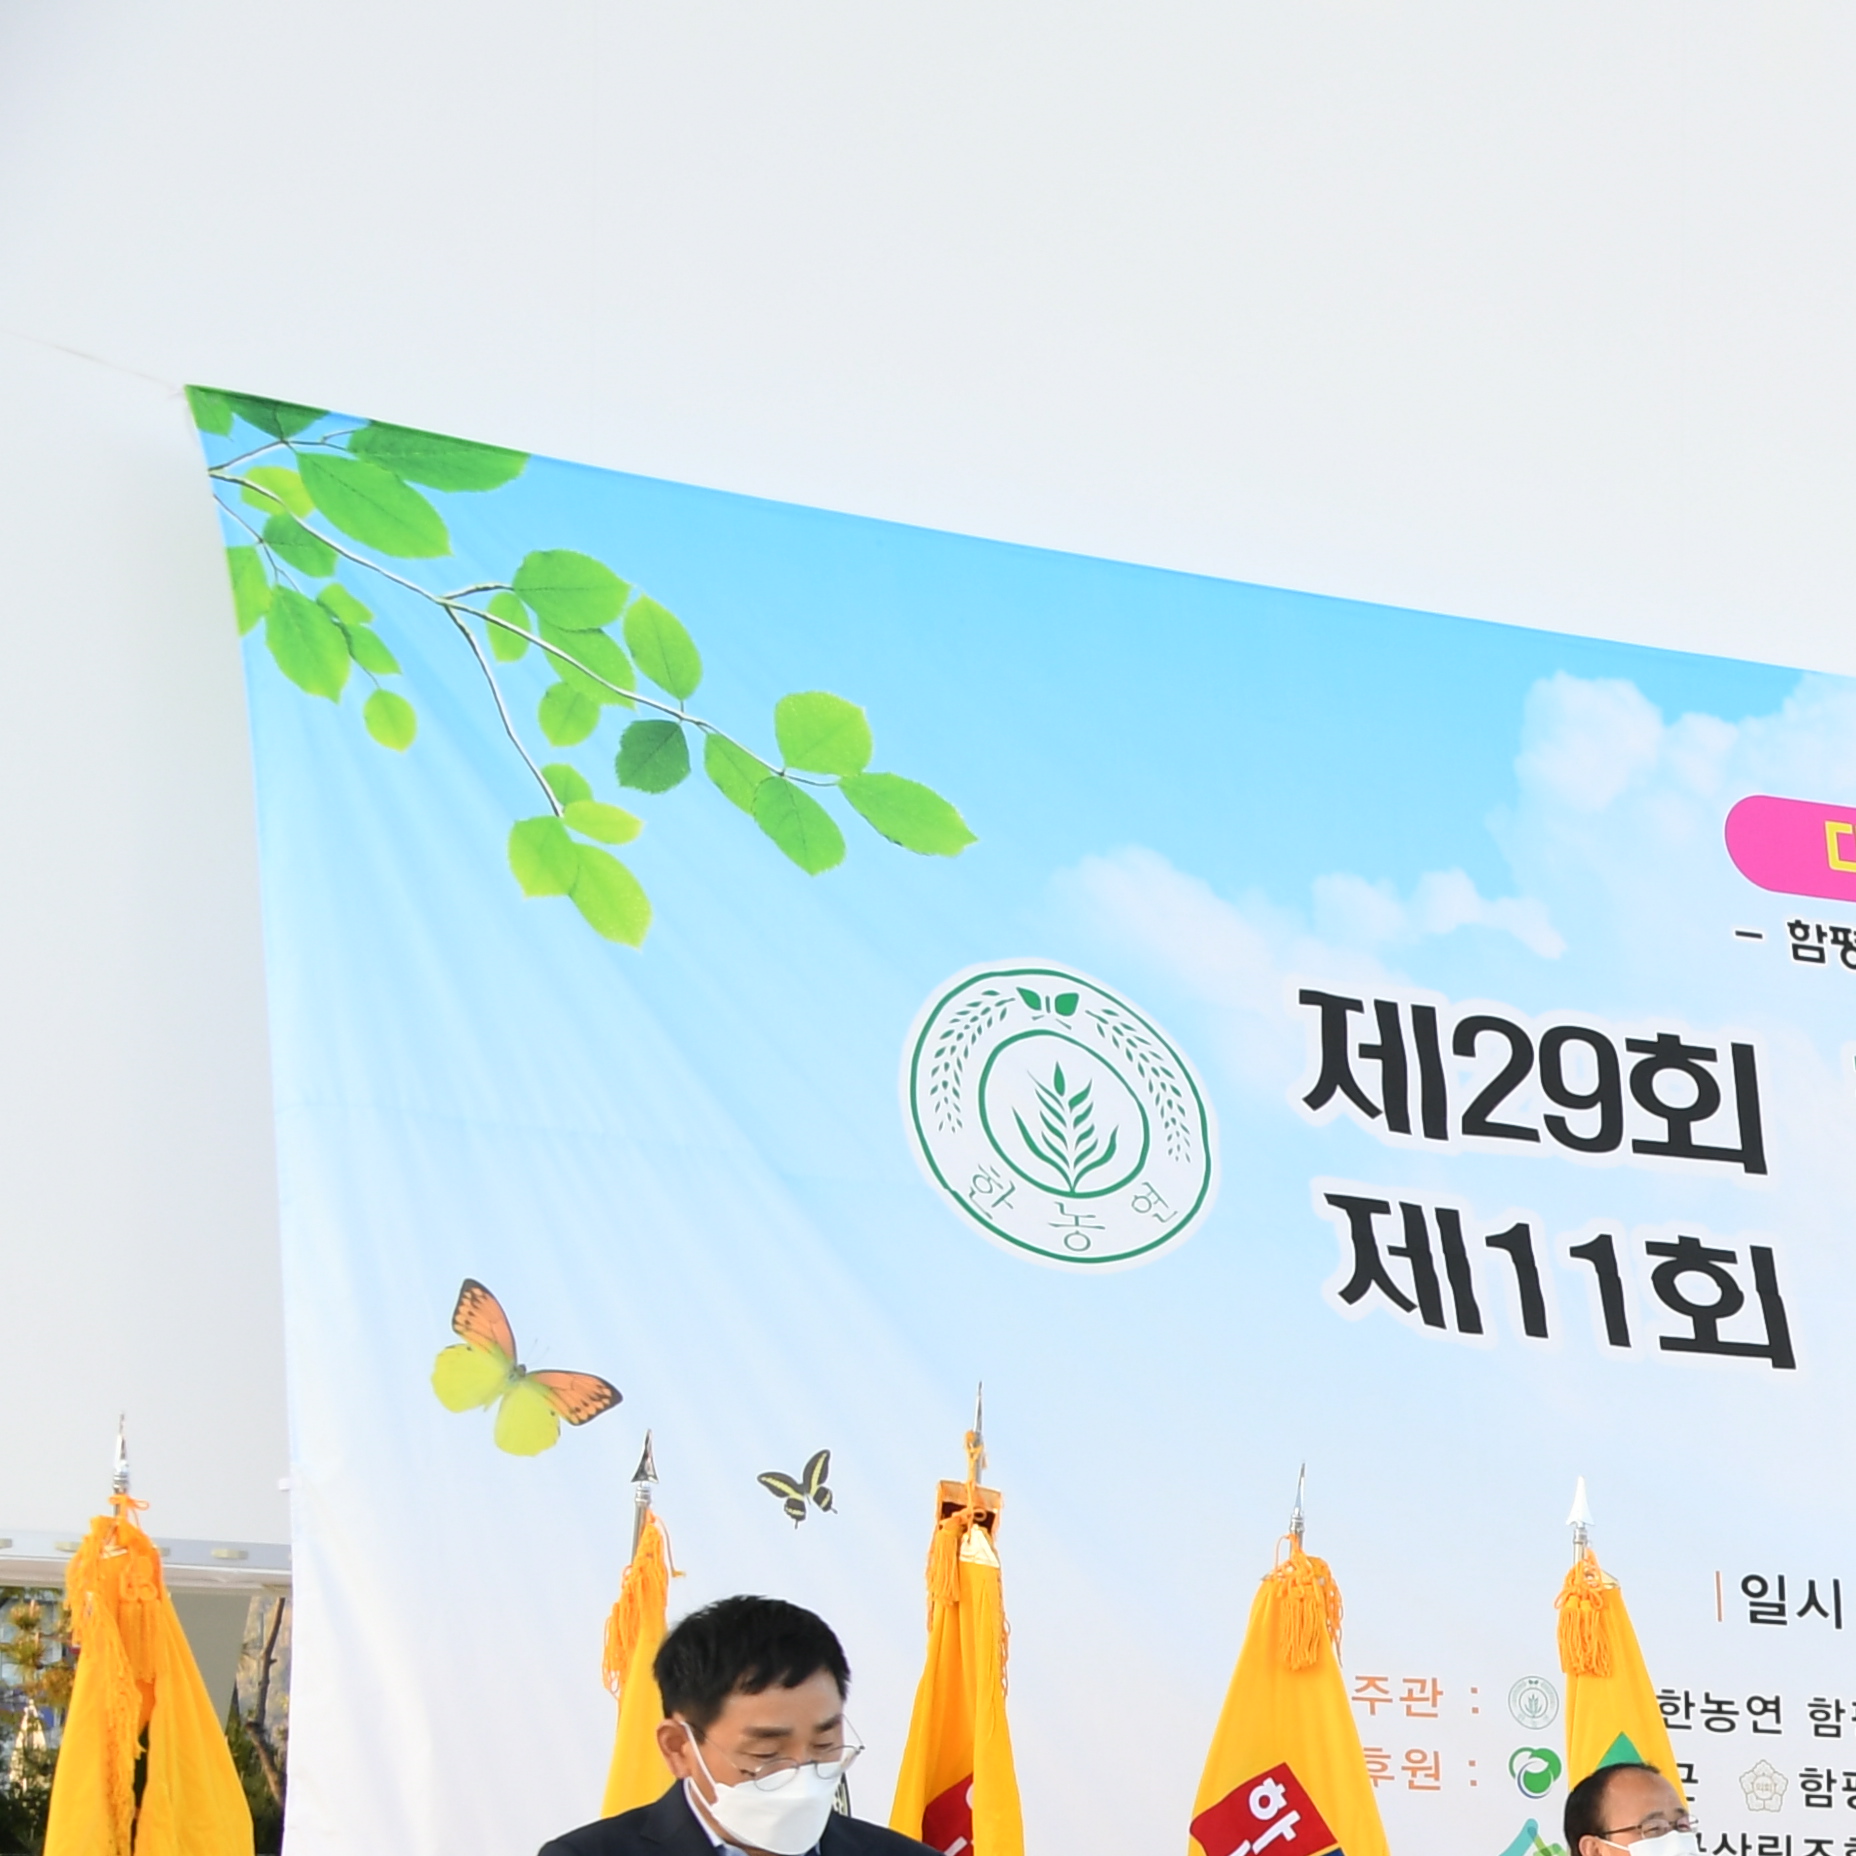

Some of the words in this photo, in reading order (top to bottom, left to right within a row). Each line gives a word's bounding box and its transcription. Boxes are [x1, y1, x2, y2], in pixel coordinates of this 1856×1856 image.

[1299, 989, 1767, 1175] 제29회
[969, 1164, 1178, 1251] 한농연
[1323, 1192, 1797, 1370] 제11회
[1740, 1574, 1842, 1630] 일시
[1351, 1675, 1444, 1718] 주관
[1656, 1688, 1783, 1735] 한농연
[1363, 1748, 1441, 1791] 후원
